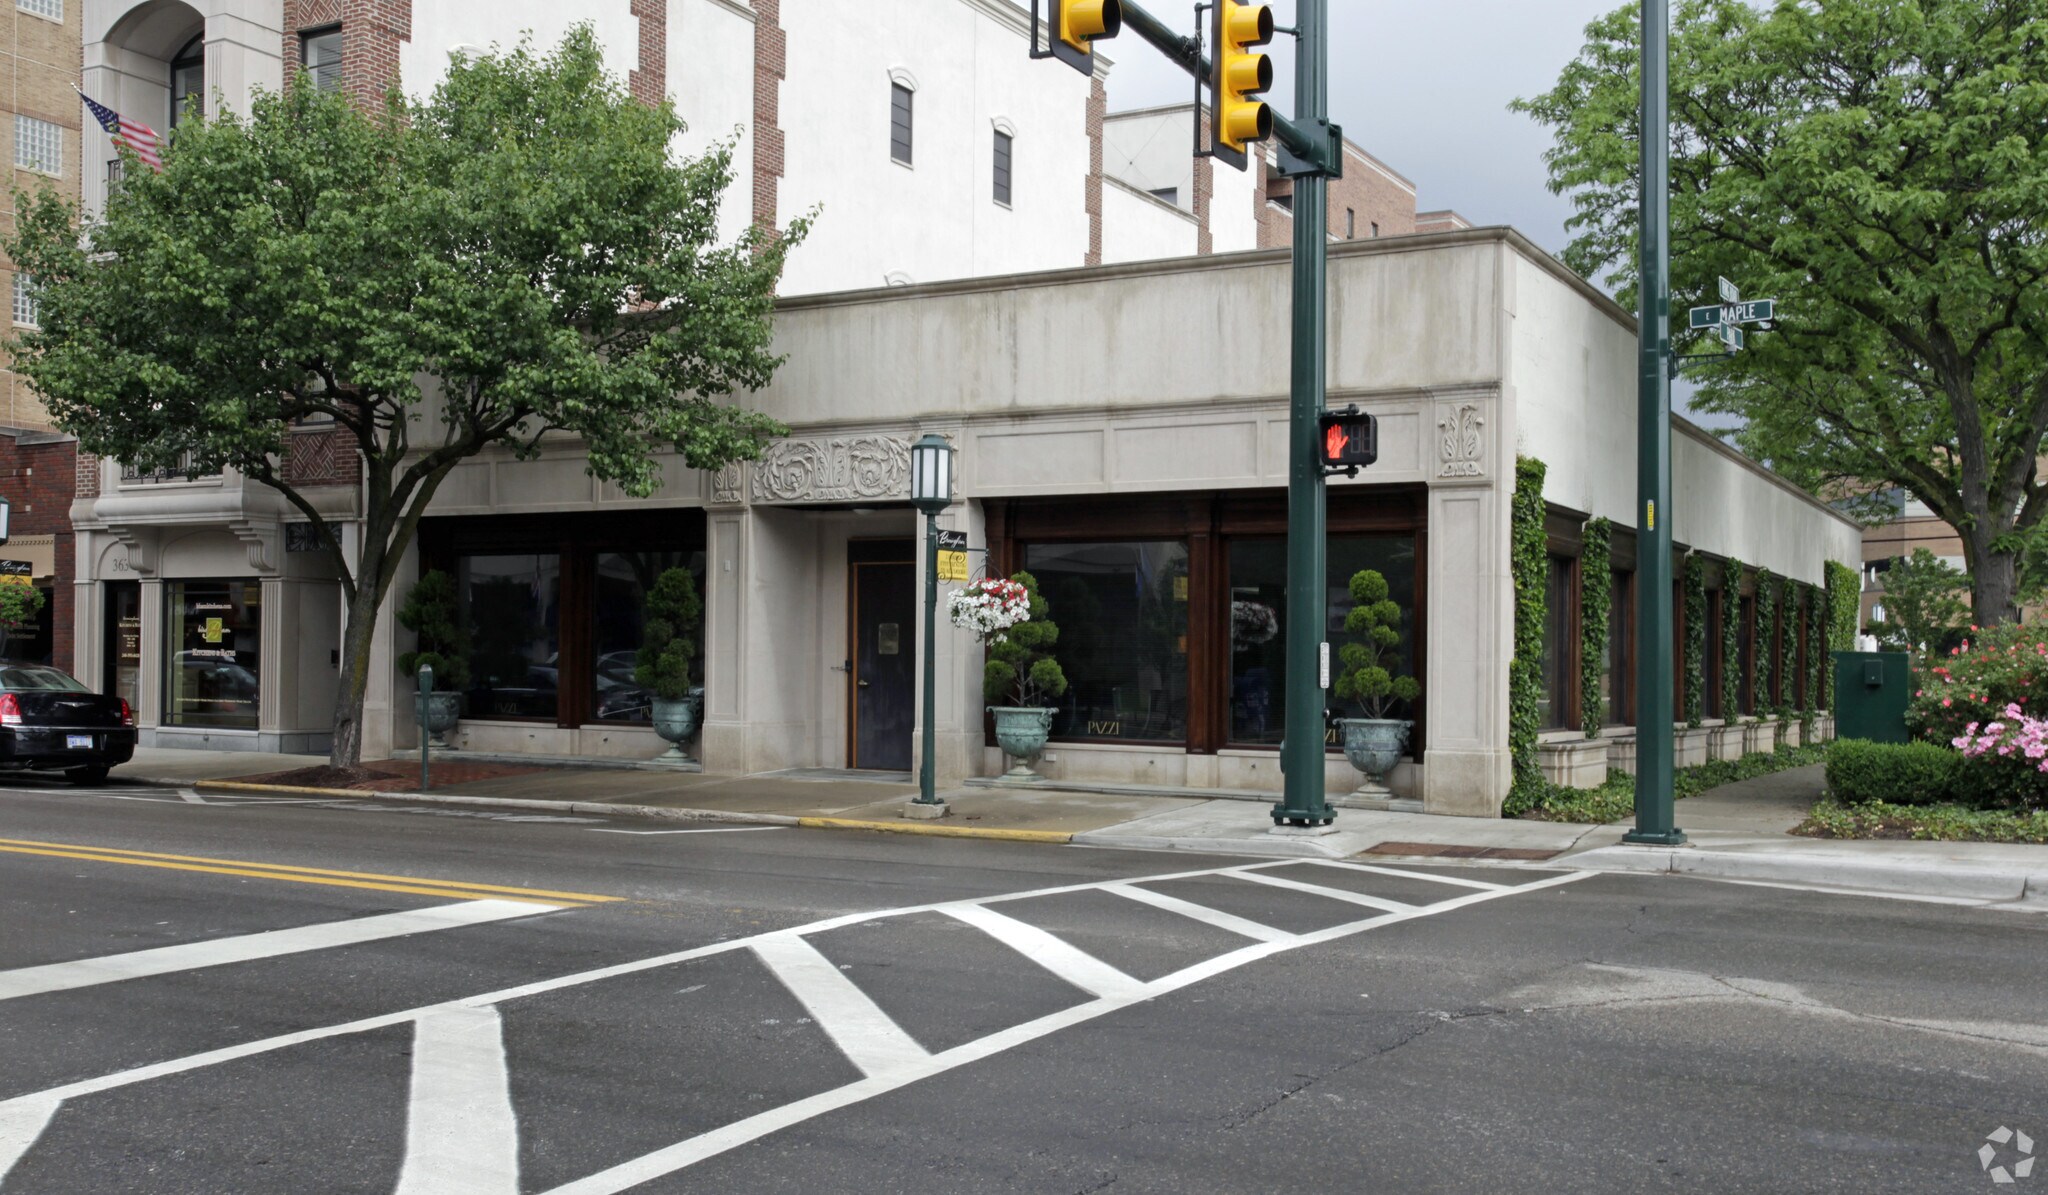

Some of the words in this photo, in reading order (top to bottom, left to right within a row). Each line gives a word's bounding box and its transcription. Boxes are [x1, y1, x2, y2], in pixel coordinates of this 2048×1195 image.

[1705, 312, 1709, 320] E
[1720, 304, 1755, 321] MAPLE
[1087, 720, 1119, 735] PAZZI
